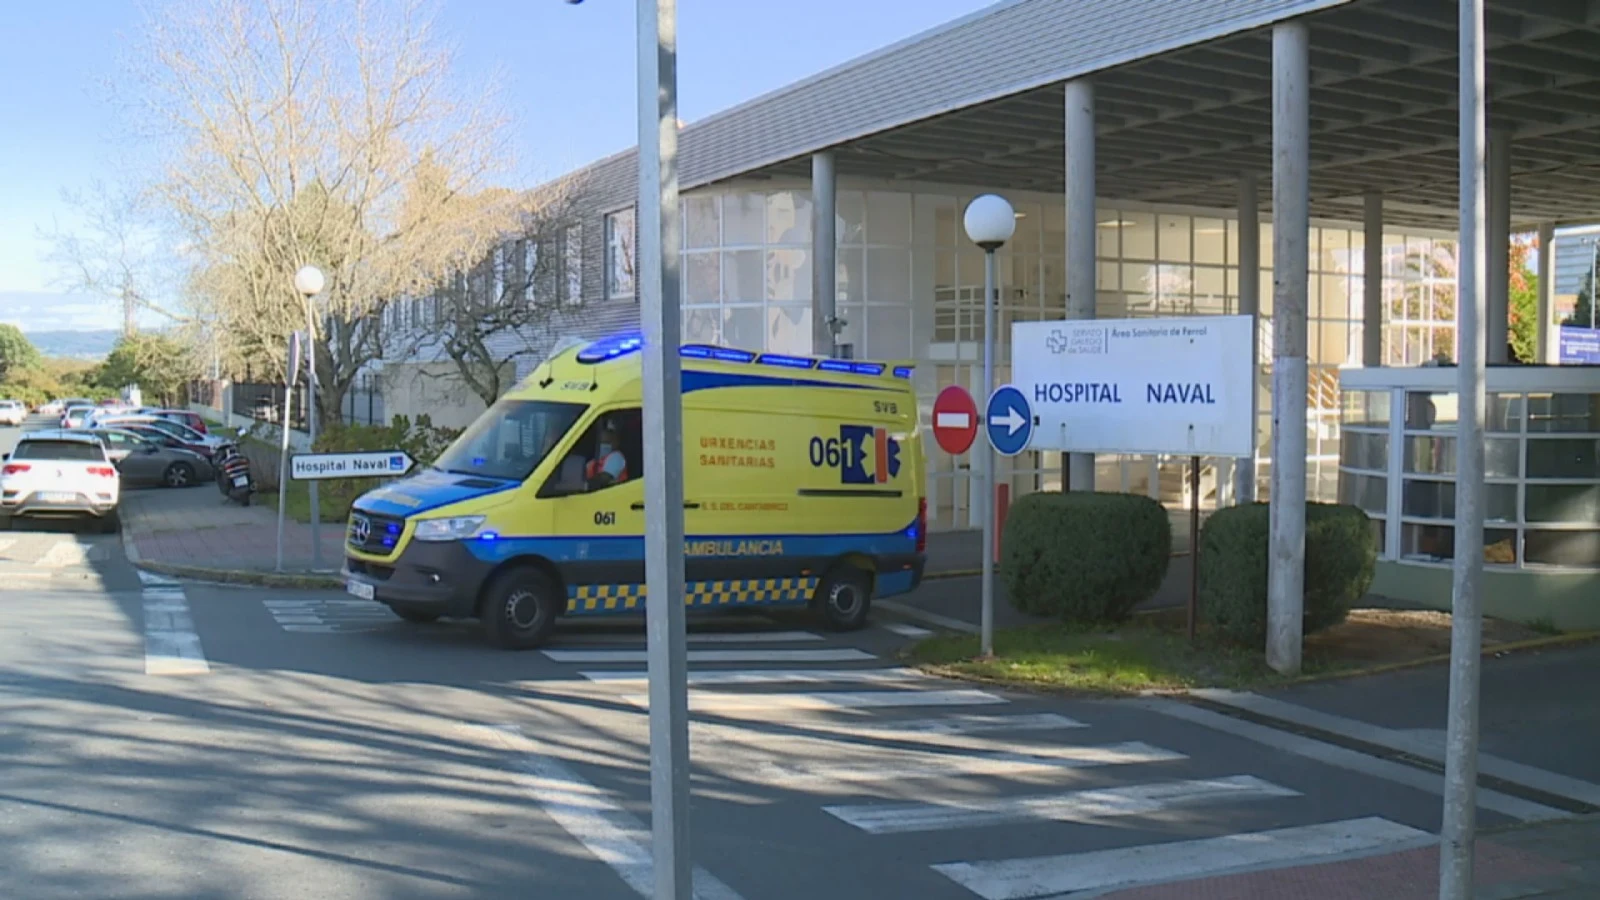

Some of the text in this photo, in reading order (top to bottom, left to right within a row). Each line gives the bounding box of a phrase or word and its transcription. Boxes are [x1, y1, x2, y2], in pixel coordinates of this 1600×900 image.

[1133, 327, 1168, 338] Sanitaria
[1170, 327, 1180, 336] de
[1183, 326, 1207, 336] Ferrol
[1034, 383, 1215, 404] HOSPITAL NAVAL
[874, 400, 898, 414] SVB
[699, 437, 776, 451] URXENCIAS
[809, 436, 853, 468] 061
[296, 459, 388, 473] Hospital Naval
[699, 454, 776, 469] SANITARIAS
[594, 511, 616, 526] 061
[683, 540, 784, 556] AMBULANCIA
